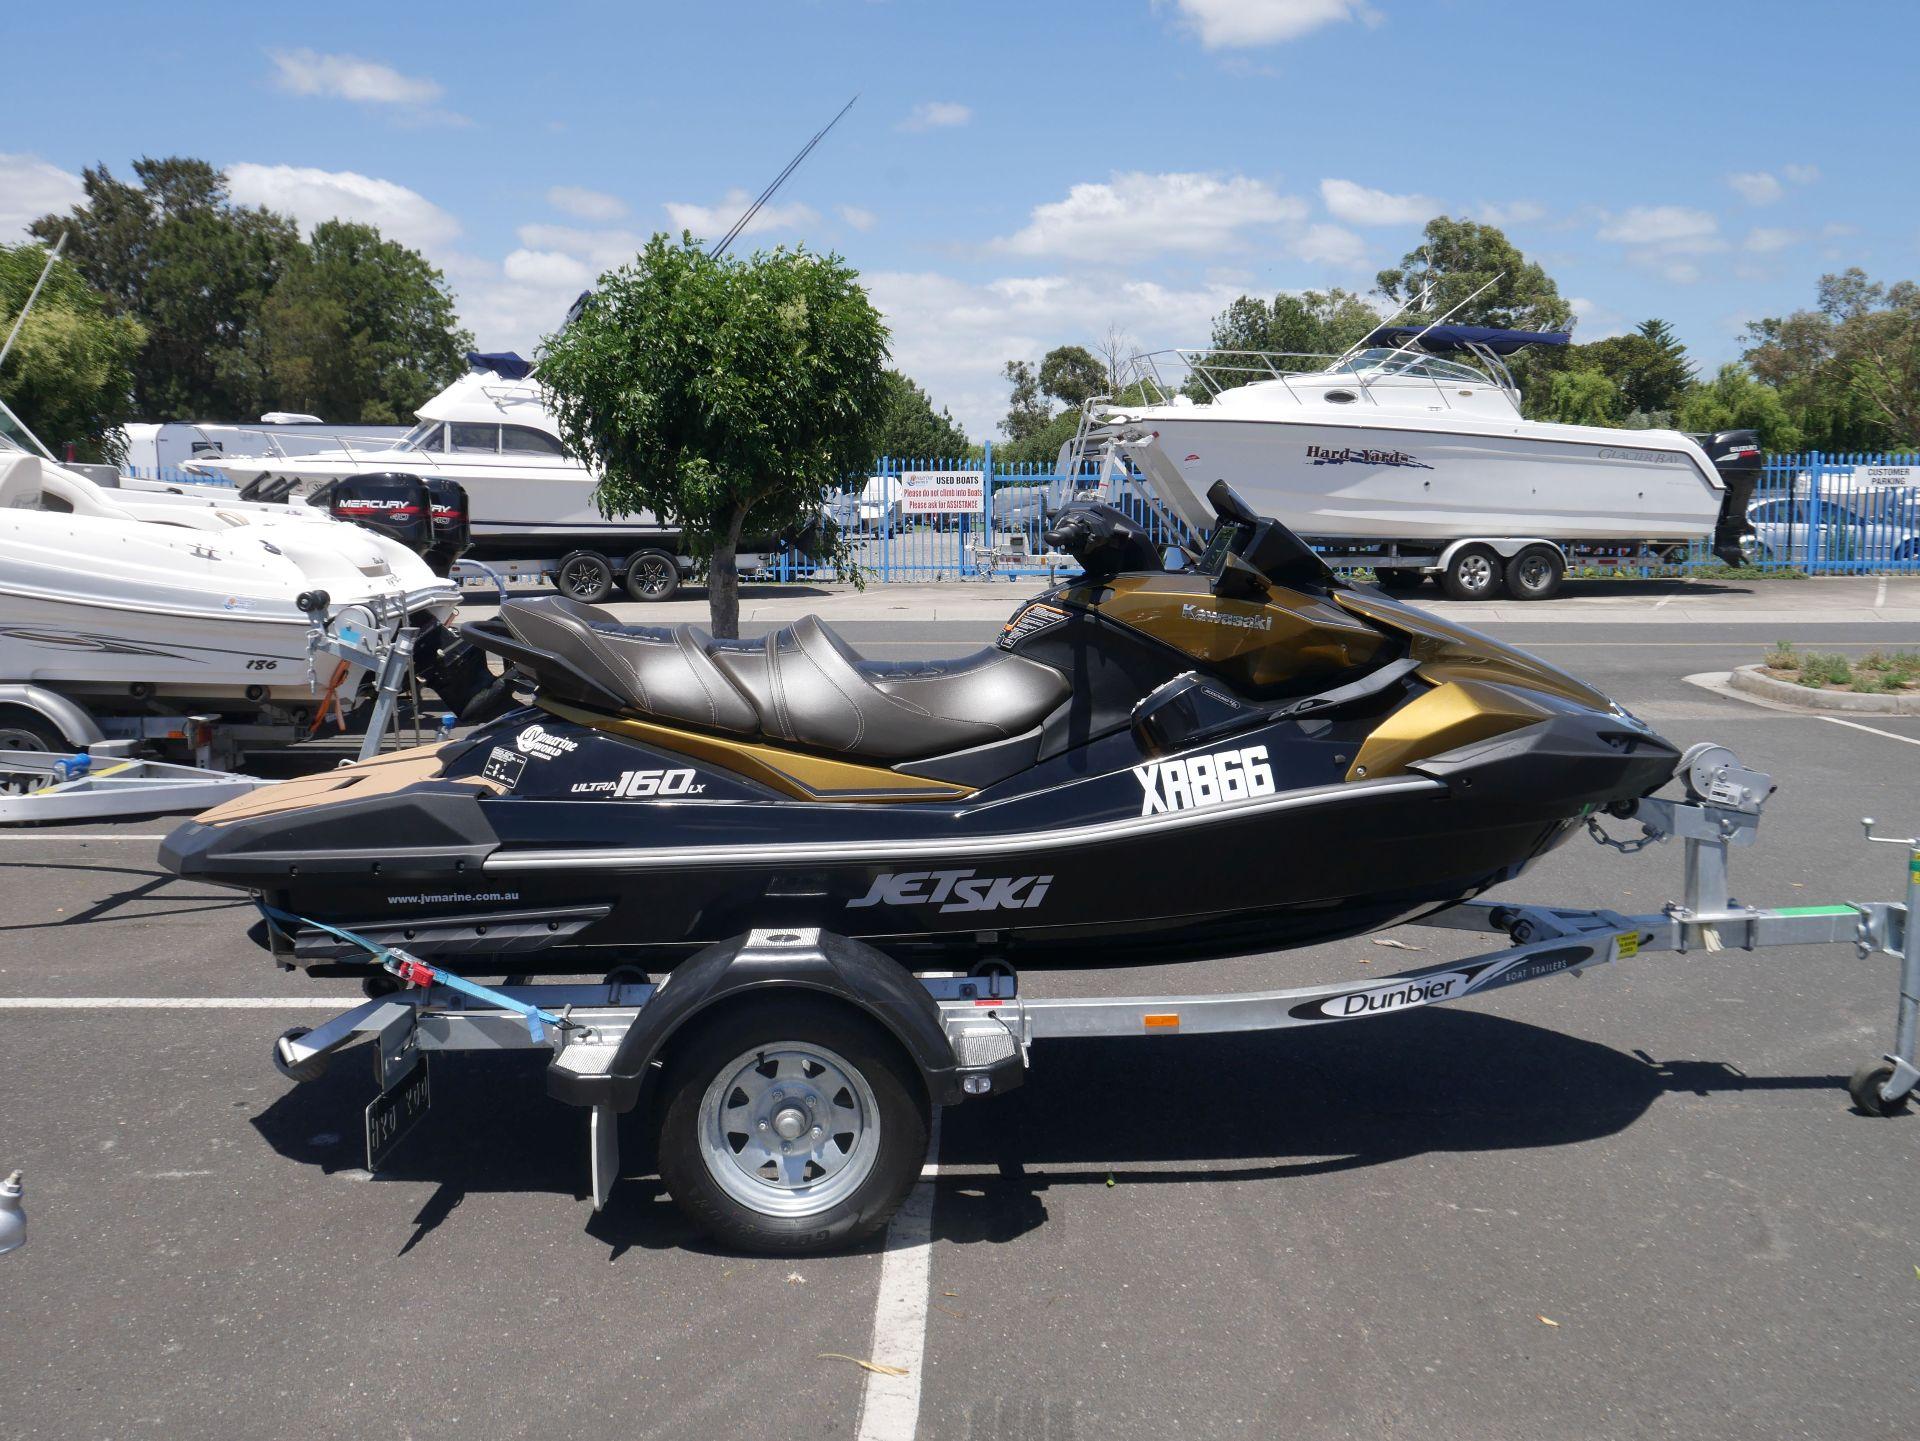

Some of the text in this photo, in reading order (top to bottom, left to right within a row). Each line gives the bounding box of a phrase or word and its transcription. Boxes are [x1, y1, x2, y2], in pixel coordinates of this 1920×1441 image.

[1306, 445, 1409, 463] Hard Yards
[1598, 449, 1680, 464] GLACIER BAY
[1867, 468, 1910, 476] CUSTOMER
[936, 476, 955, 485] USED
[956, 476, 979, 485] BOATS
[1871, 477, 1906, 485] PARKING
[904, 489, 983, 497] Please do not climb into Boats
[339, 499, 410, 510] MERCURY
[909, 500, 978, 509] Please ask for ASSISTANCE
[389, 512, 410, 521] 40
[1182, 603, 1273, 631] Kawasaki
[245, 659, 278, 671] 186
[532, 742, 562, 757] WORLD
[570, 768, 707, 797] ULTRA 160 LX
[1132, 744, 1276, 817] XA866
[387, 892, 519, 904] www.jvmarine.com.au
[1505, 959, 1568, 982] BOAT TRAILERS
[1343, 979, 1457, 1016] Dunbier
